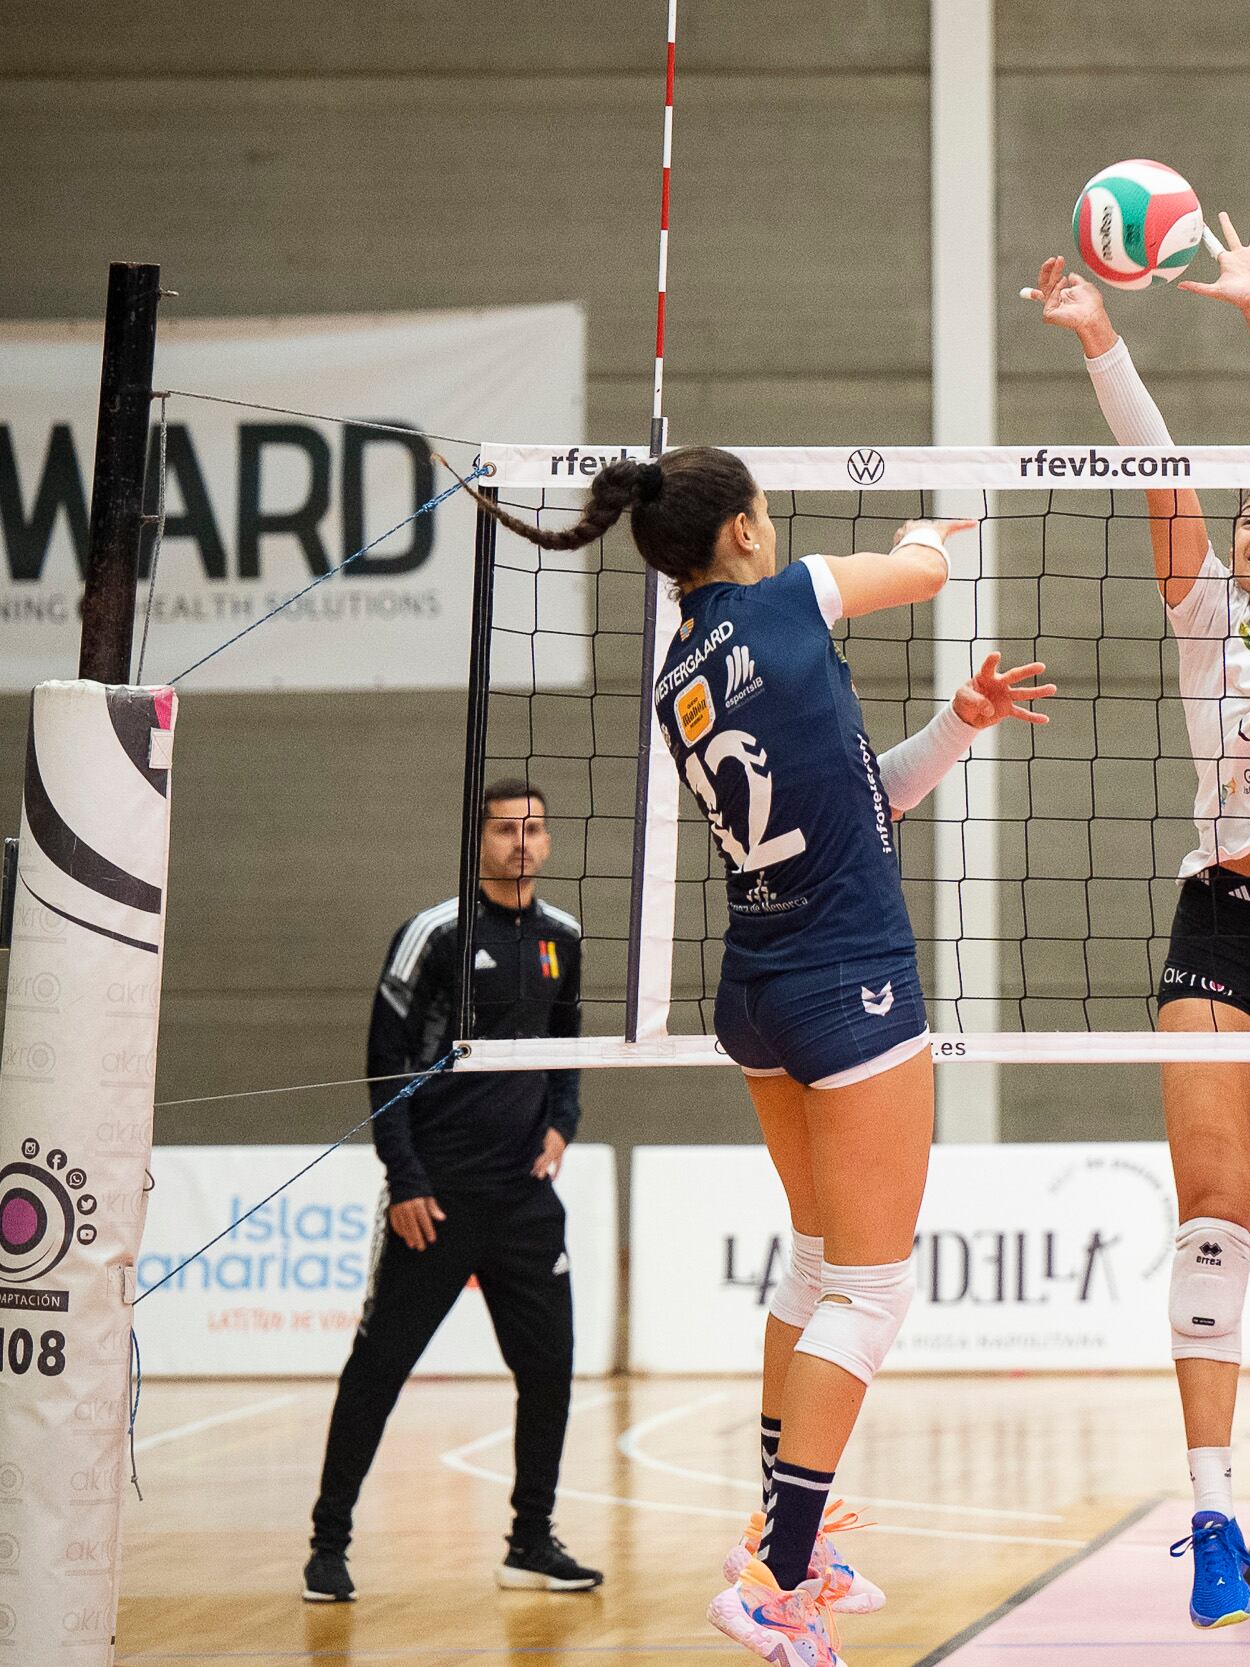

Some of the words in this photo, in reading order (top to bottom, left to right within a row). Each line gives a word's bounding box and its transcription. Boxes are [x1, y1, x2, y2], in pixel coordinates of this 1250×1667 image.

[1020, 449, 1191, 477] rfevb.com
[231, 1195, 367, 1242] Islas
[137, 1249, 364, 1291] anarias
[0, 1294, 60, 1307] APTACIÓN
[0, 1327, 65, 1376] 08
